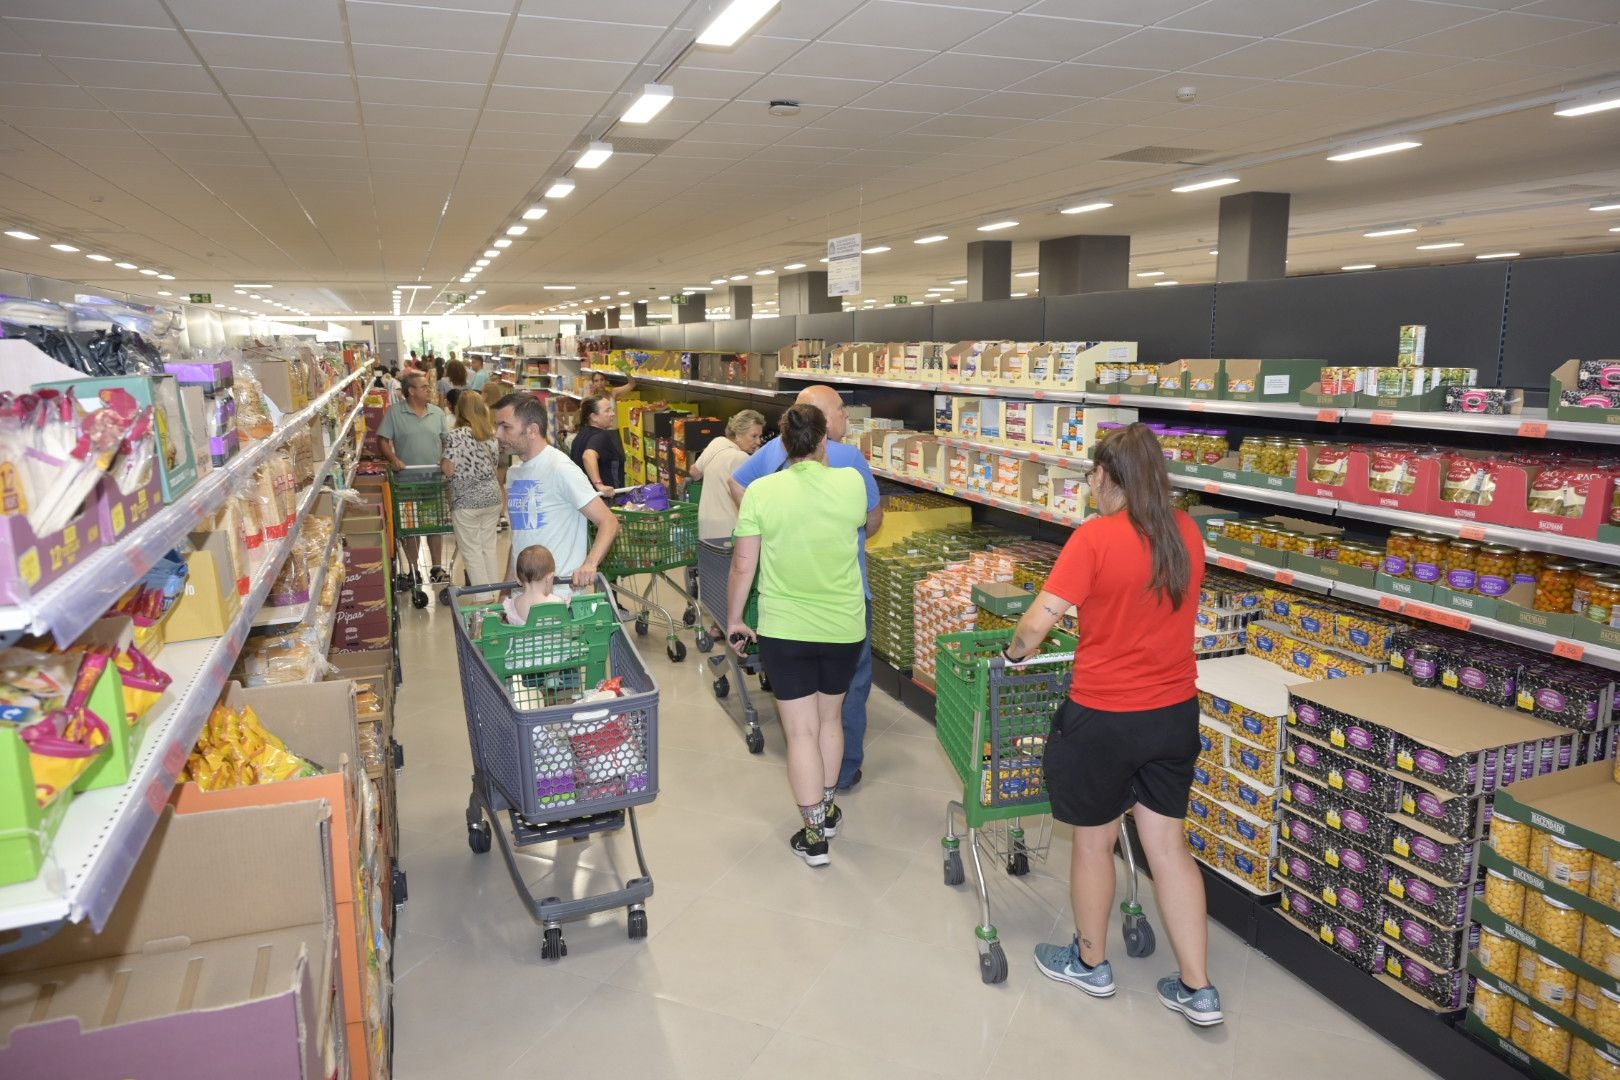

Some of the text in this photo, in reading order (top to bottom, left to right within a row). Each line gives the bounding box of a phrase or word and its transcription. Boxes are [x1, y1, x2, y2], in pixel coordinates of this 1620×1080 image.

[337, 611, 364, 624] Pipas
[1531, 812, 1566, 835] HACENDADO
[1512, 866, 1546, 891] HACENDADO
